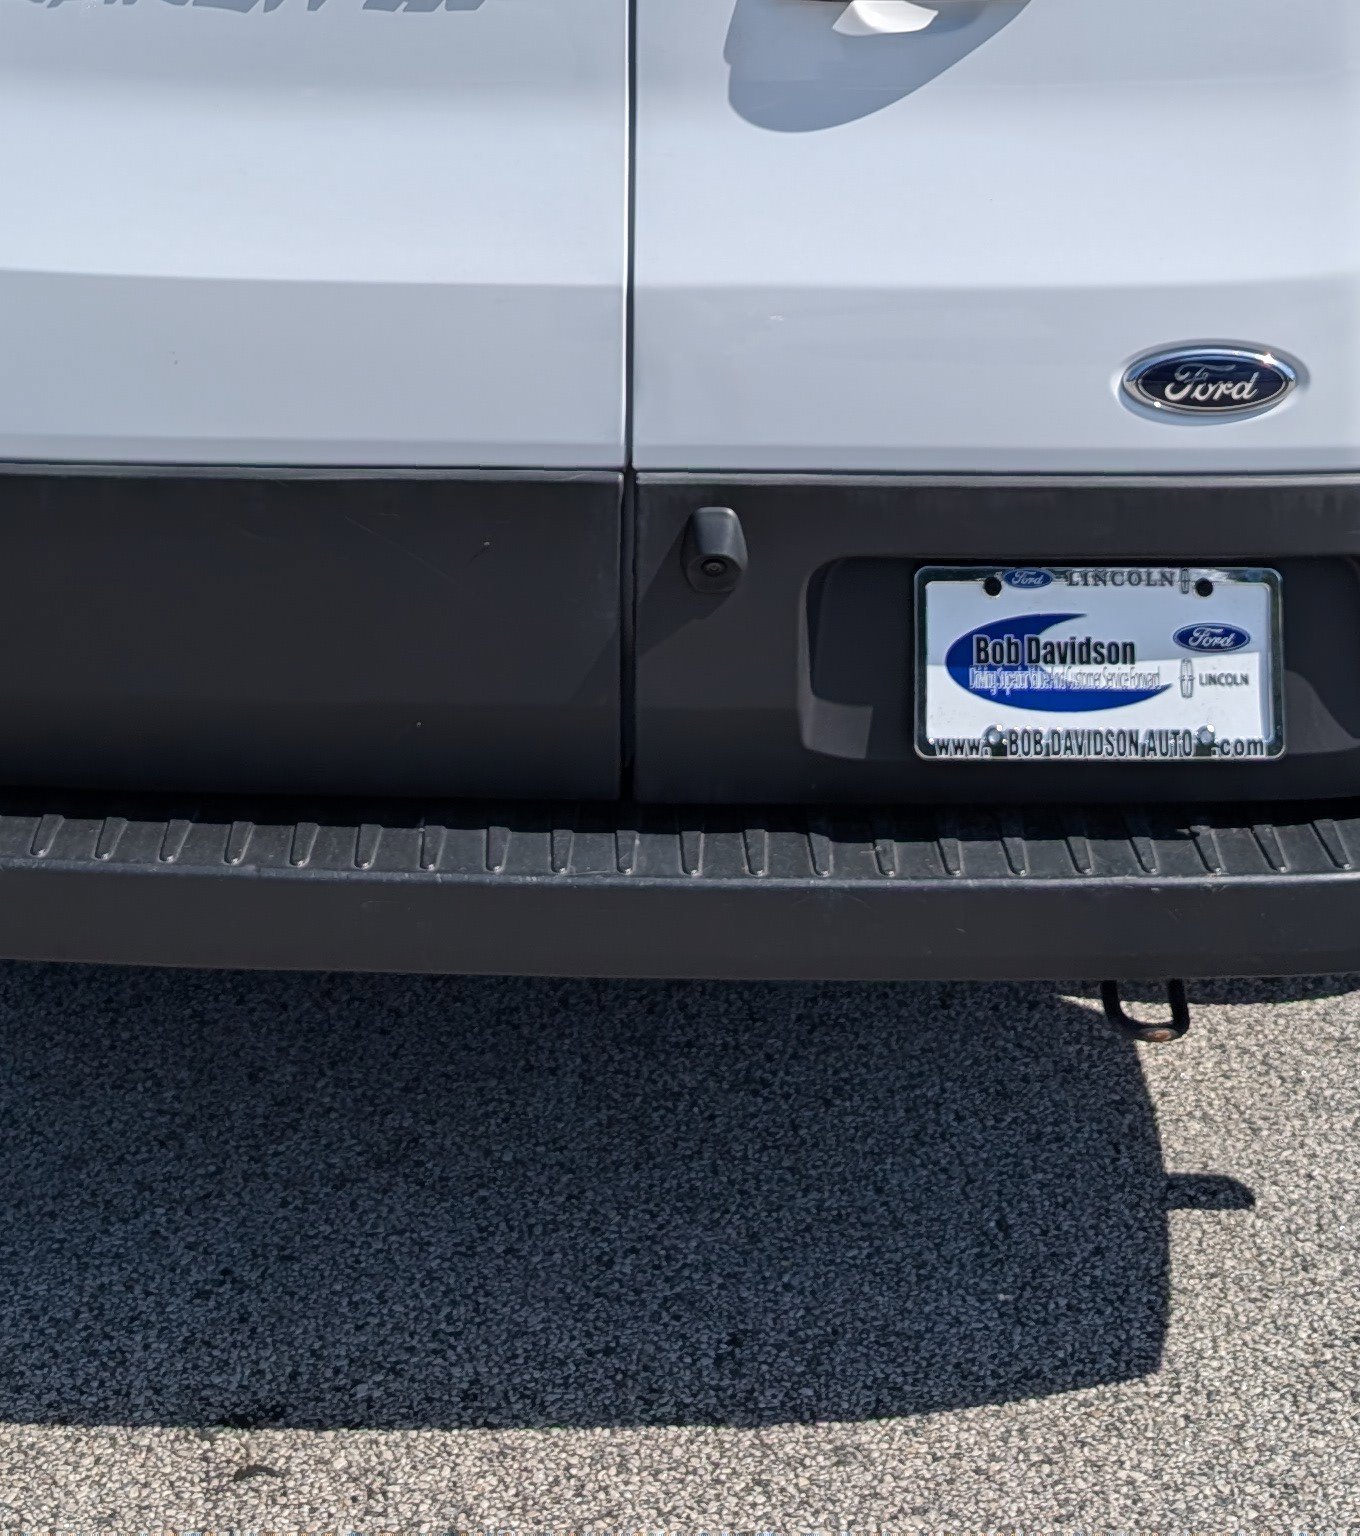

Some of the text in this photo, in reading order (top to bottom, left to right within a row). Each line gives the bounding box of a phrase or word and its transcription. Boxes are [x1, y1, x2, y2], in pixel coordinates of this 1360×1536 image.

[1163, 363, 1261, 402] Ford
[1011, 568, 1177, 588] Ford LINCOLN
[1188, 625, 1235, 648] Ford
[974, 635, 1136, 666] Bob Davidson
[1198, 672, 1249, 687] LINCOLN
